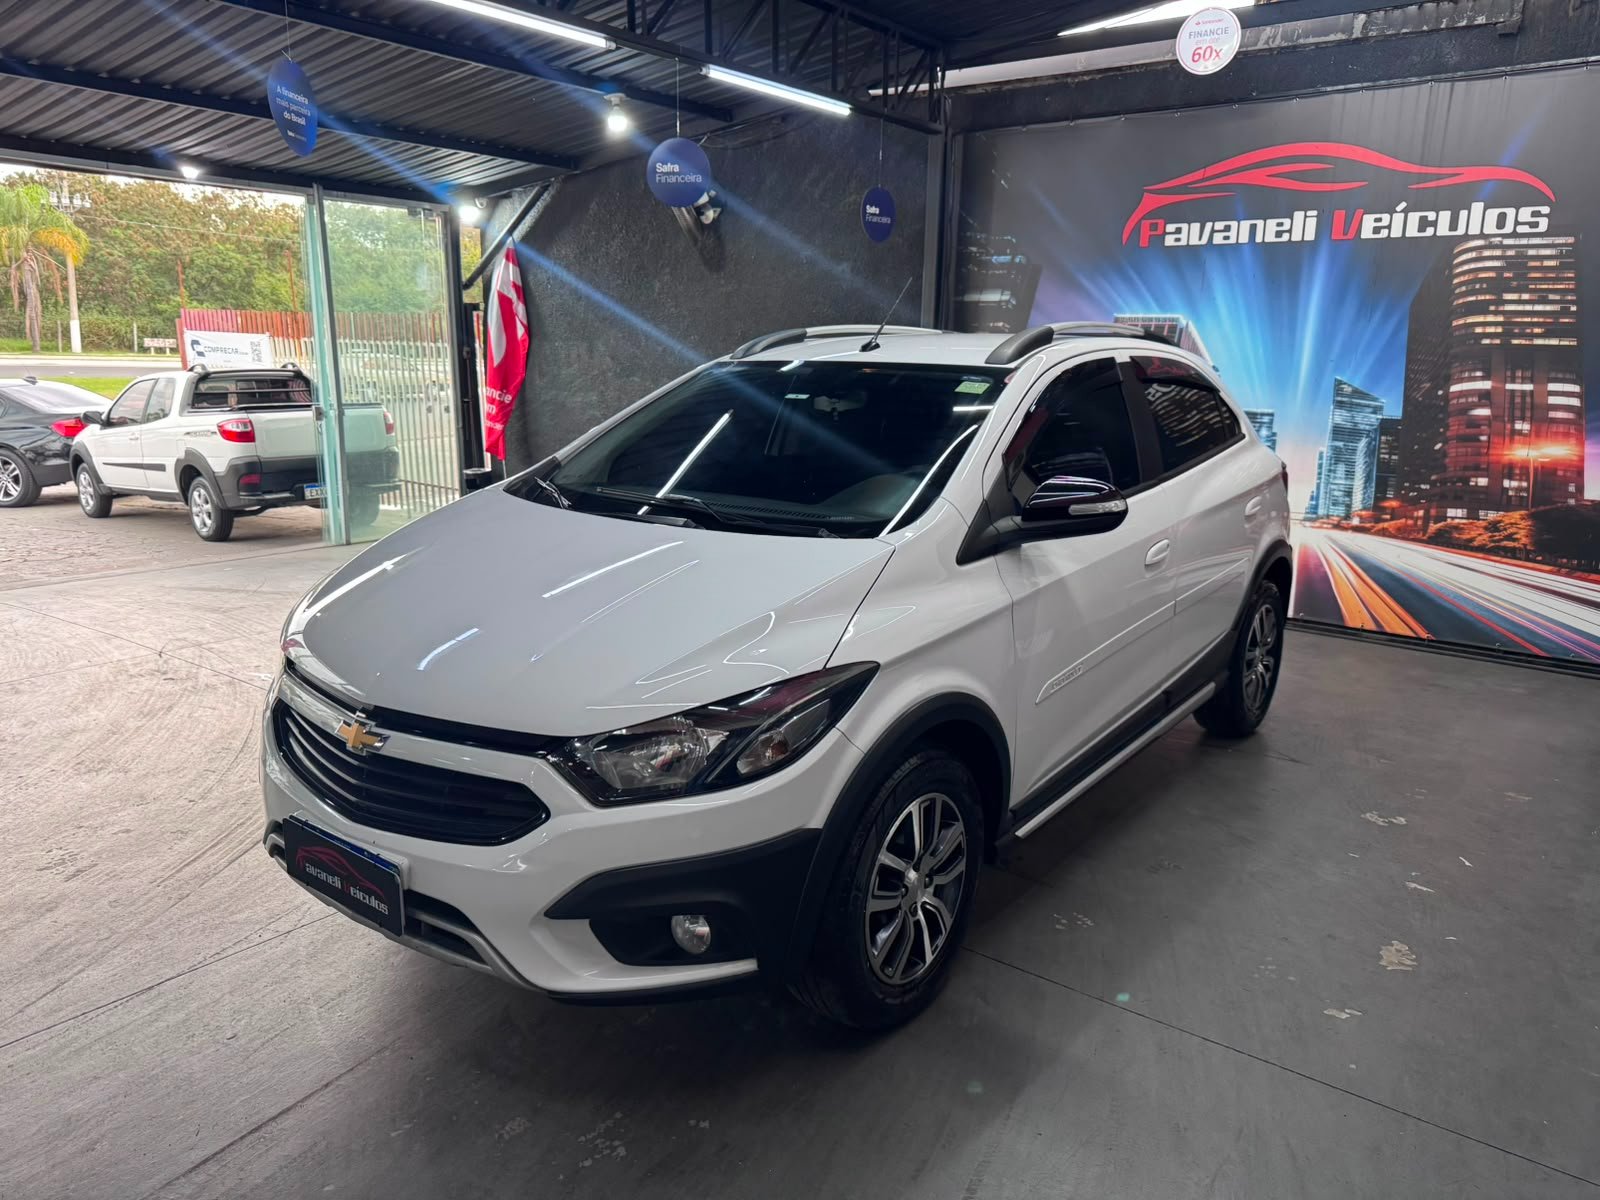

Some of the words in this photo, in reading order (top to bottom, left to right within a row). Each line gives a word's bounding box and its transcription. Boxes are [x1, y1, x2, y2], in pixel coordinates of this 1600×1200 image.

[1188, 27, 1229, 39] FINANCIE
[1191, 45, 1223, 63] 60x
[655, 162, 680, 173] Safra
[655, 172, 702, 183] Financeira
[866, 204, 880, 214] Safra
[1139, 210, 1318, 248] Pavaneli
[1331, 200, 1551, 241] Veículos
